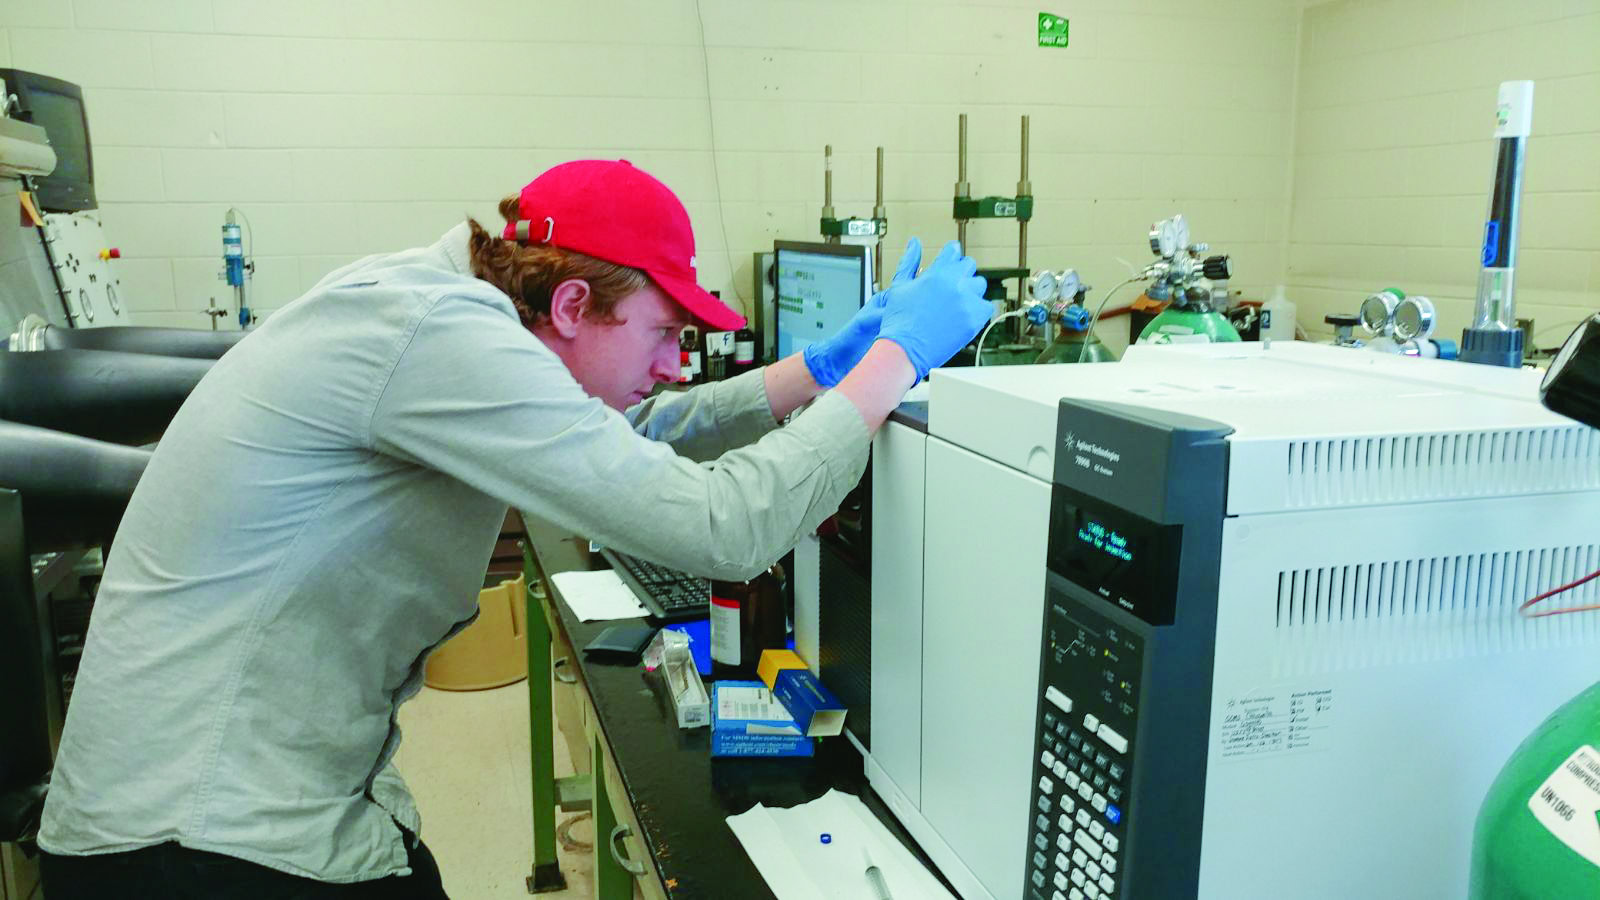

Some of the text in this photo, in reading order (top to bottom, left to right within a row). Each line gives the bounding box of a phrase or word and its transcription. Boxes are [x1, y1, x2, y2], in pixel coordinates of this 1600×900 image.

[1040, 36, 1067, 45] FIRST AID
[1076, 439, 1120, 462] Agilent Technologies
[1540, 785, 1576, 822] UN1066
